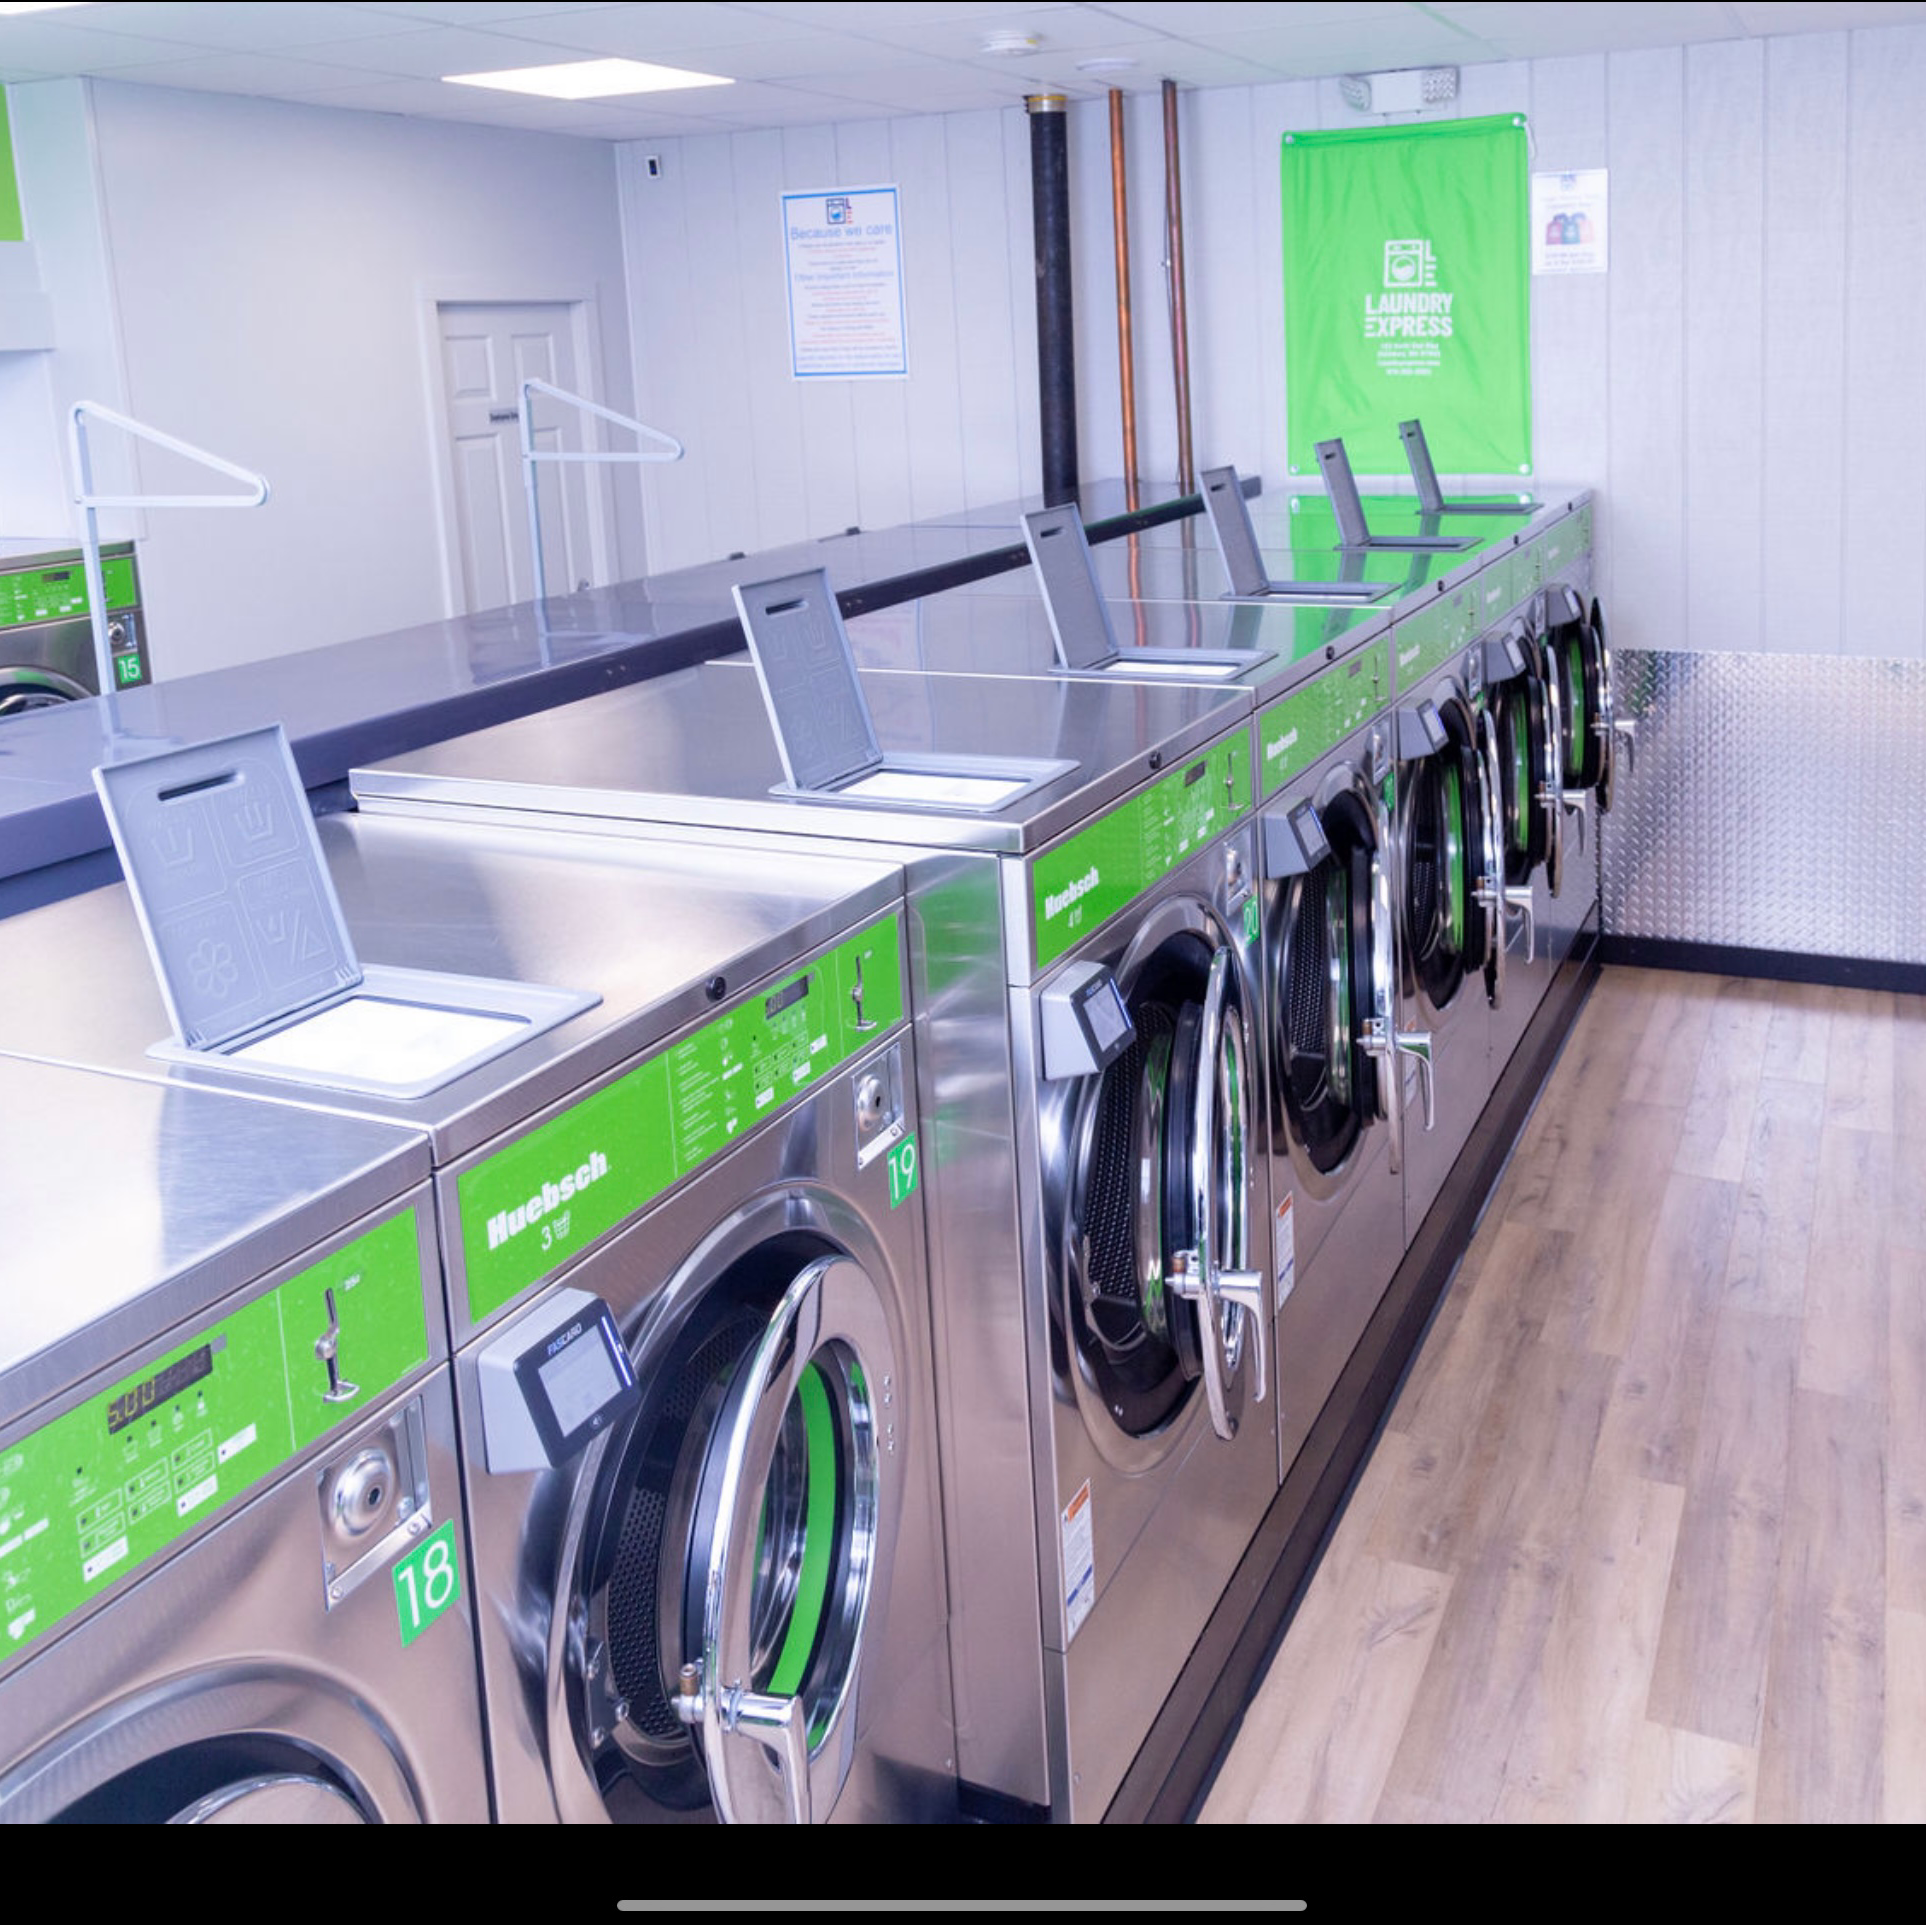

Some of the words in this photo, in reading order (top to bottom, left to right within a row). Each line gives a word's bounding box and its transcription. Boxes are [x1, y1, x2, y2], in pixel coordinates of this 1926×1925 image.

[790, 226, 842, 240] Because
[845, 226, 861, 236] we
[866, 224, 893, 235] care
[1365, 292, 1453, 314] LAUNDRY
[1364, 315, 1453, 338] EXPRESS
[118, 658, 140, 679] 15
[1045, 865, 1100, 921] Huebsch
[888, 1143, 916, 1200] 19
[486, 1150, 608, 1251] Huebsch
[541, 1224, 553, 1251] 3
[398, 1540, 454, 1628] 18
